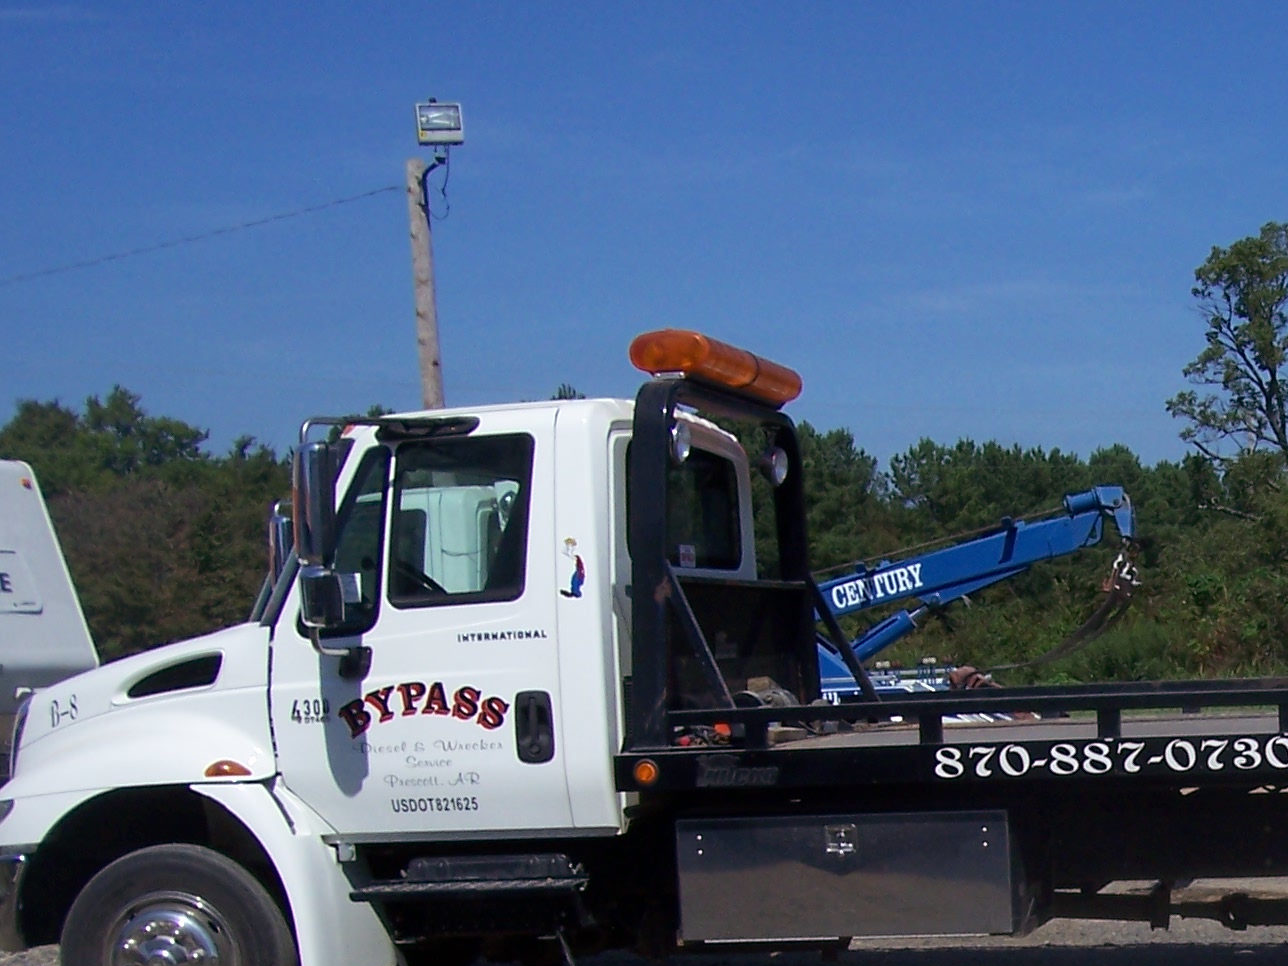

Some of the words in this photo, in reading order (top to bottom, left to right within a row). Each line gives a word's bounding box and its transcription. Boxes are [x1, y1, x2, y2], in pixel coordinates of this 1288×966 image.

[831, 563, 924, 609] CENTURY
[457, 629, 548, 643] INTERNATIONAL
[50, 693, 78, 728] B-8
[338, 681, 511, 739] BYPASS
[353, 741, 407, 754] Diesel
[433, 738, 503, 752] Wrecker
[405, 755, 453, 768] Service
[390, 797, 479, 813] USDOT821625
